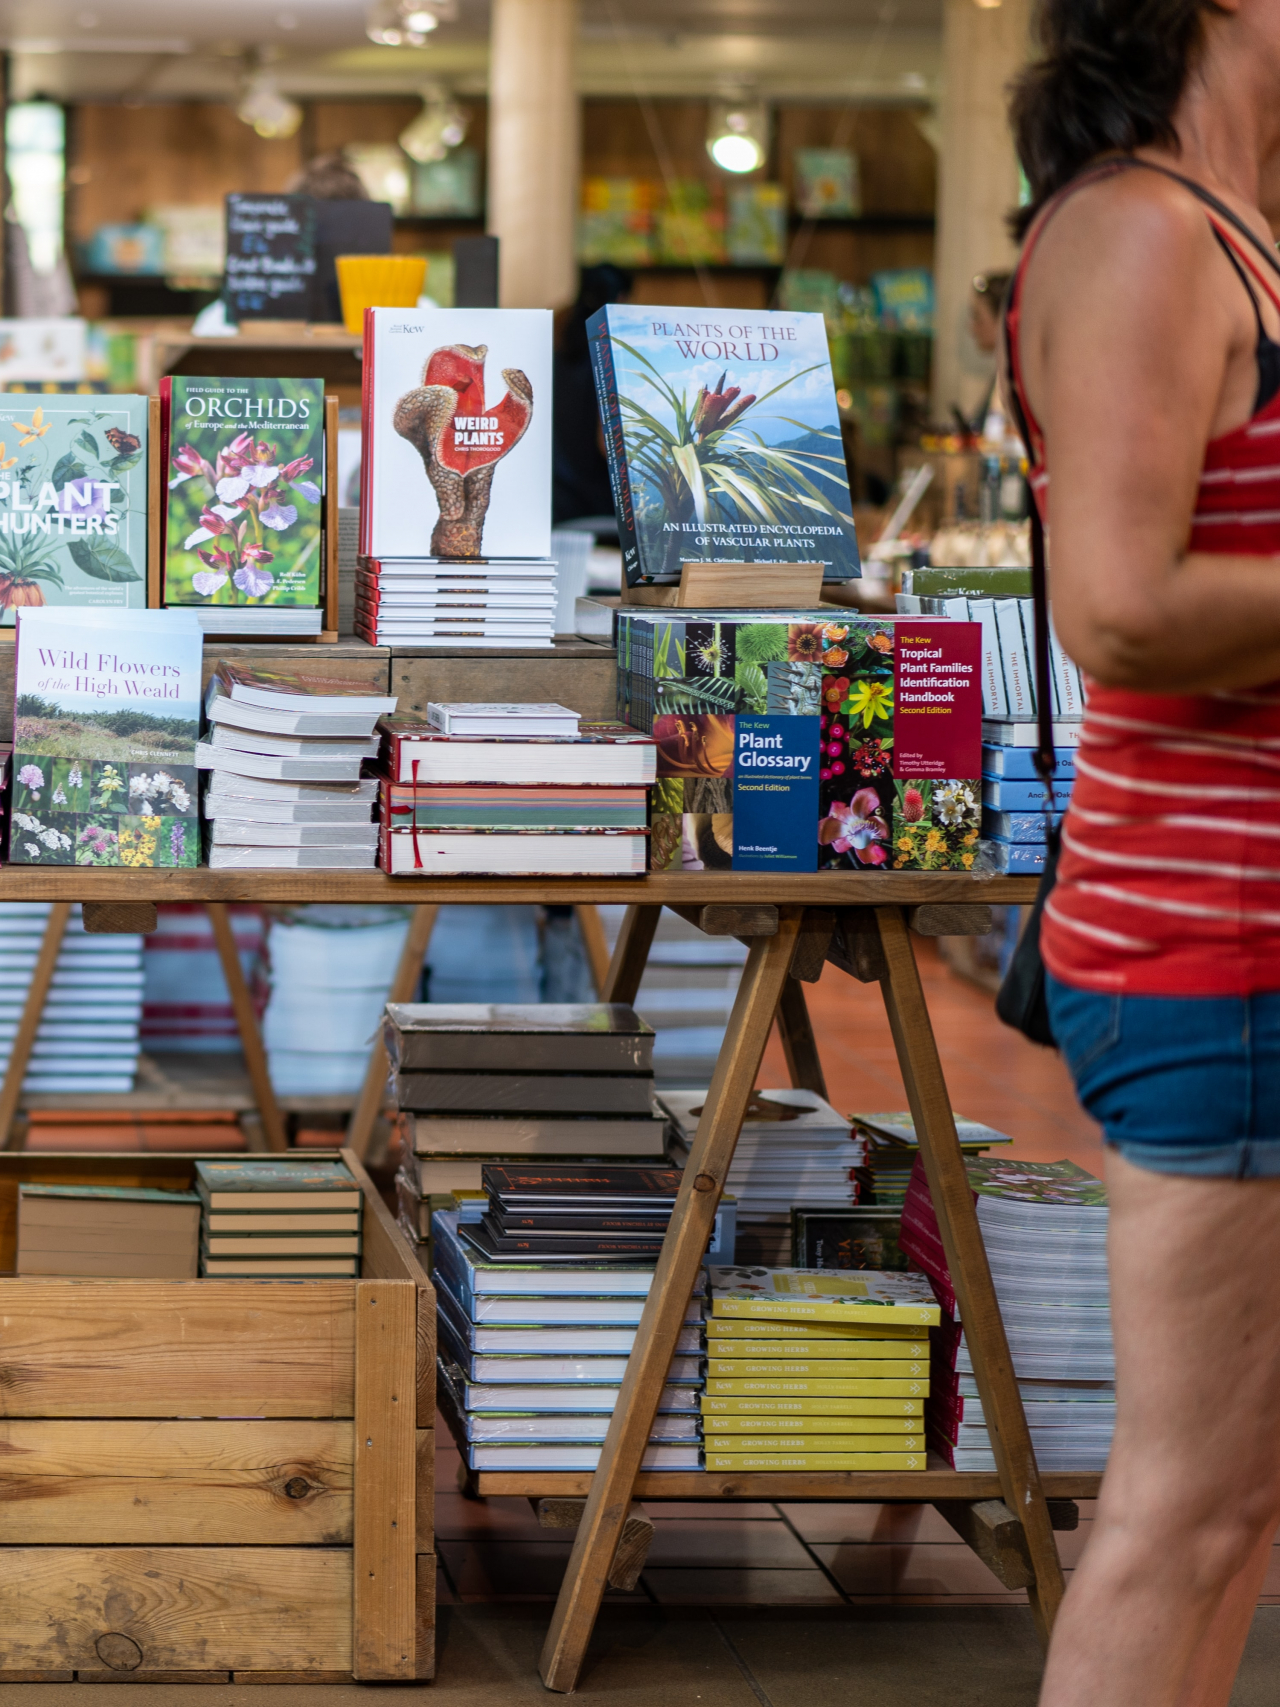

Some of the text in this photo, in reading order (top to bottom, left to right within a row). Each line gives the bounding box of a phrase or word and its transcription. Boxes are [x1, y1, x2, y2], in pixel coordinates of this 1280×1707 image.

[403, 324, 425, 334] Kew
[652, 322, 797, 341] PLANTS OF THE
[598, 322, 616, 390] PLANTS
[675, 340, 779, 362] WORLD
[185, 396, 310, 418] ORCHIDS
[608, 392, 620, 422] OF
[185, 422, 194, 430] of
[193, 420, 224, 431] Europe
[248, 421, 310, 430] Mediterranean
[454, 416, 499, 430] WEIRD
[454, 432, 504, 445] PLANTS
[613, 424, 625, 460] THE
[620, 461, 634, 532] WORLD
[662, 523, 844, 536] AN ILLUSTRATED ENCYCLOPEDIA
[695, 536, 816, 548] OF VASCULAR PLANTS
[624, 545, 636, 562] Kew
[958, 587, 985, 596] Kew
[900, 636, 932, 644] The Kew
[900, 648, 942, 661] Tropical
[37, 648, 181, 678] Wild Flowers
[900, 662, 973, 673] Plant Families
[37, 675, 179, 700] of the High Weald
[900, 677, 970, 688] Identification
[985, 651, 999, 712] THE IMMORTAL
[1010, 651, 1024, 712] THE IMMORTAL
[900, 691, 955, 702] Handbook
[1062, 670, 1075, 713] IMMORTAL
[738, 721, 753, 729] The
[739, 732, 783, 749] Plant
[131, 749, 179, 758] CHRIS CLENNETT
[916, 752, 924, 760] by
[738, 751, 812, 772] Glossary
[926, 766, 946, 774] Bramley
[737, 783, 790, 792] Second Edition
[722, 1302, 815, 1315] Kew GROWING HERBS
[716, 1324, 734, 1332] Kew
